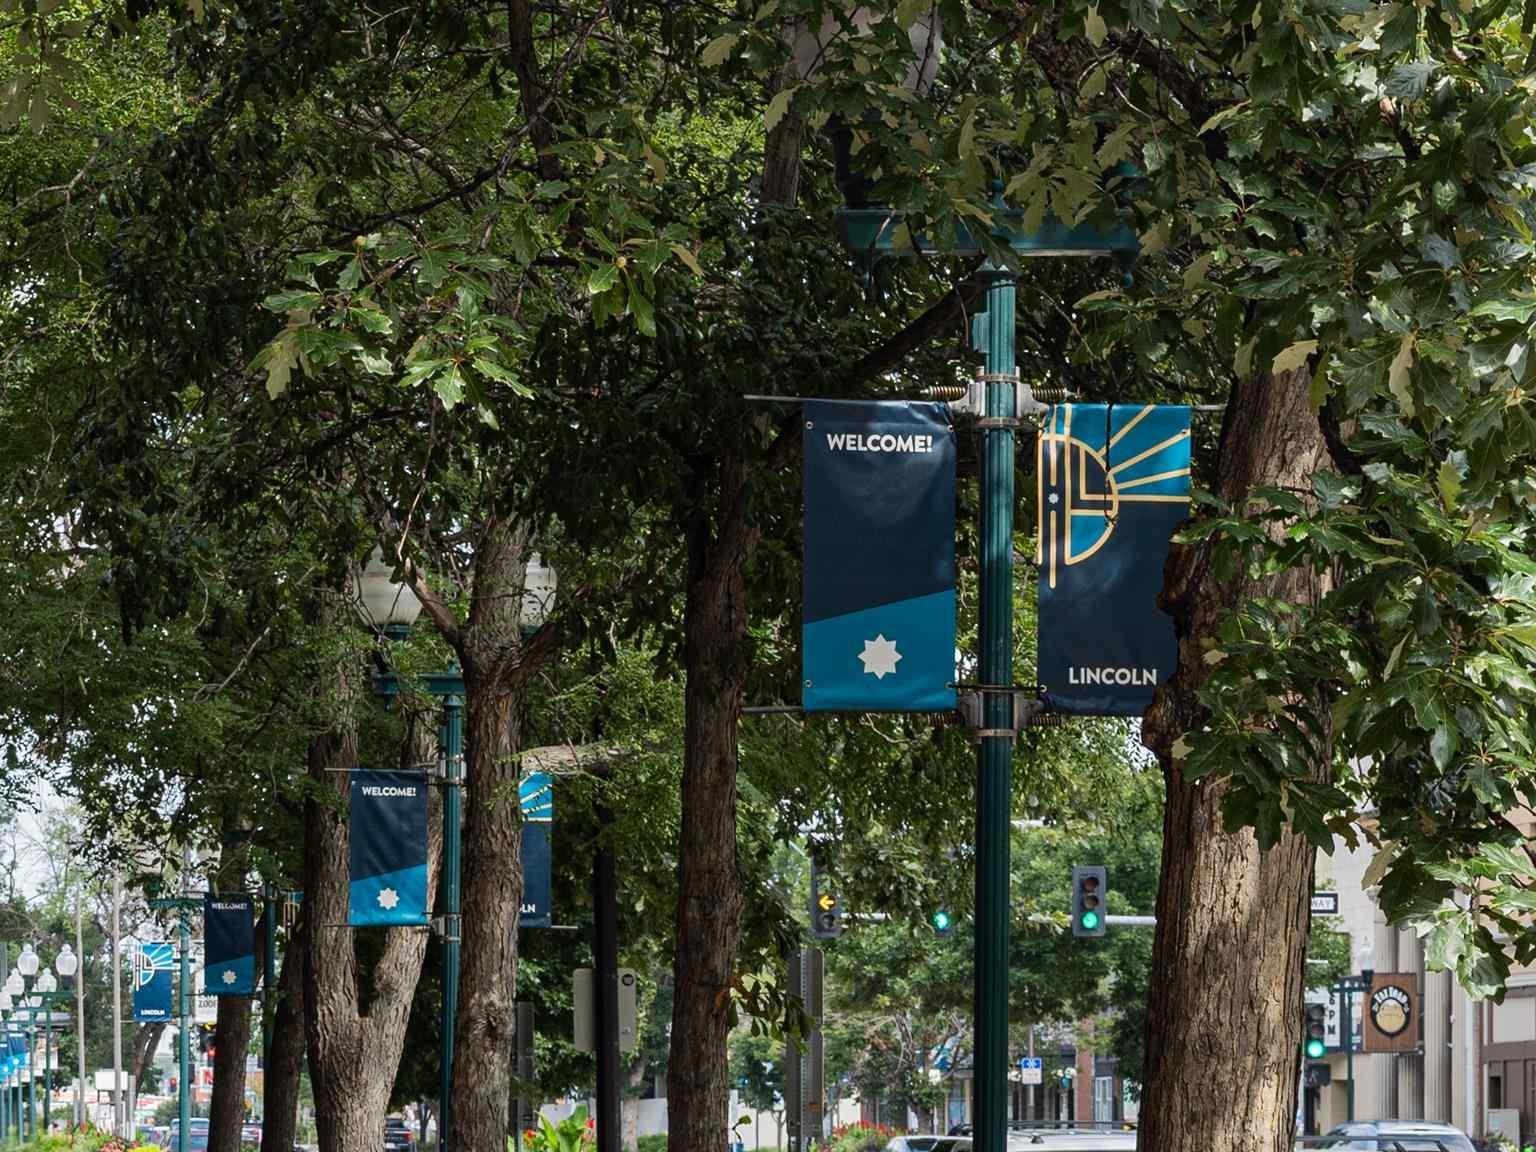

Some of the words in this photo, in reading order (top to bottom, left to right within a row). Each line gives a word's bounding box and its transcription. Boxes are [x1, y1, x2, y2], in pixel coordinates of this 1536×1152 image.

[826, 432, 933, 453] WELCOME!
[1068, 666, 1157, 686] LINCOLN
[361, 785, 417, 798] WELCOME!
[211, 902, 248, 911] WELCOME!
